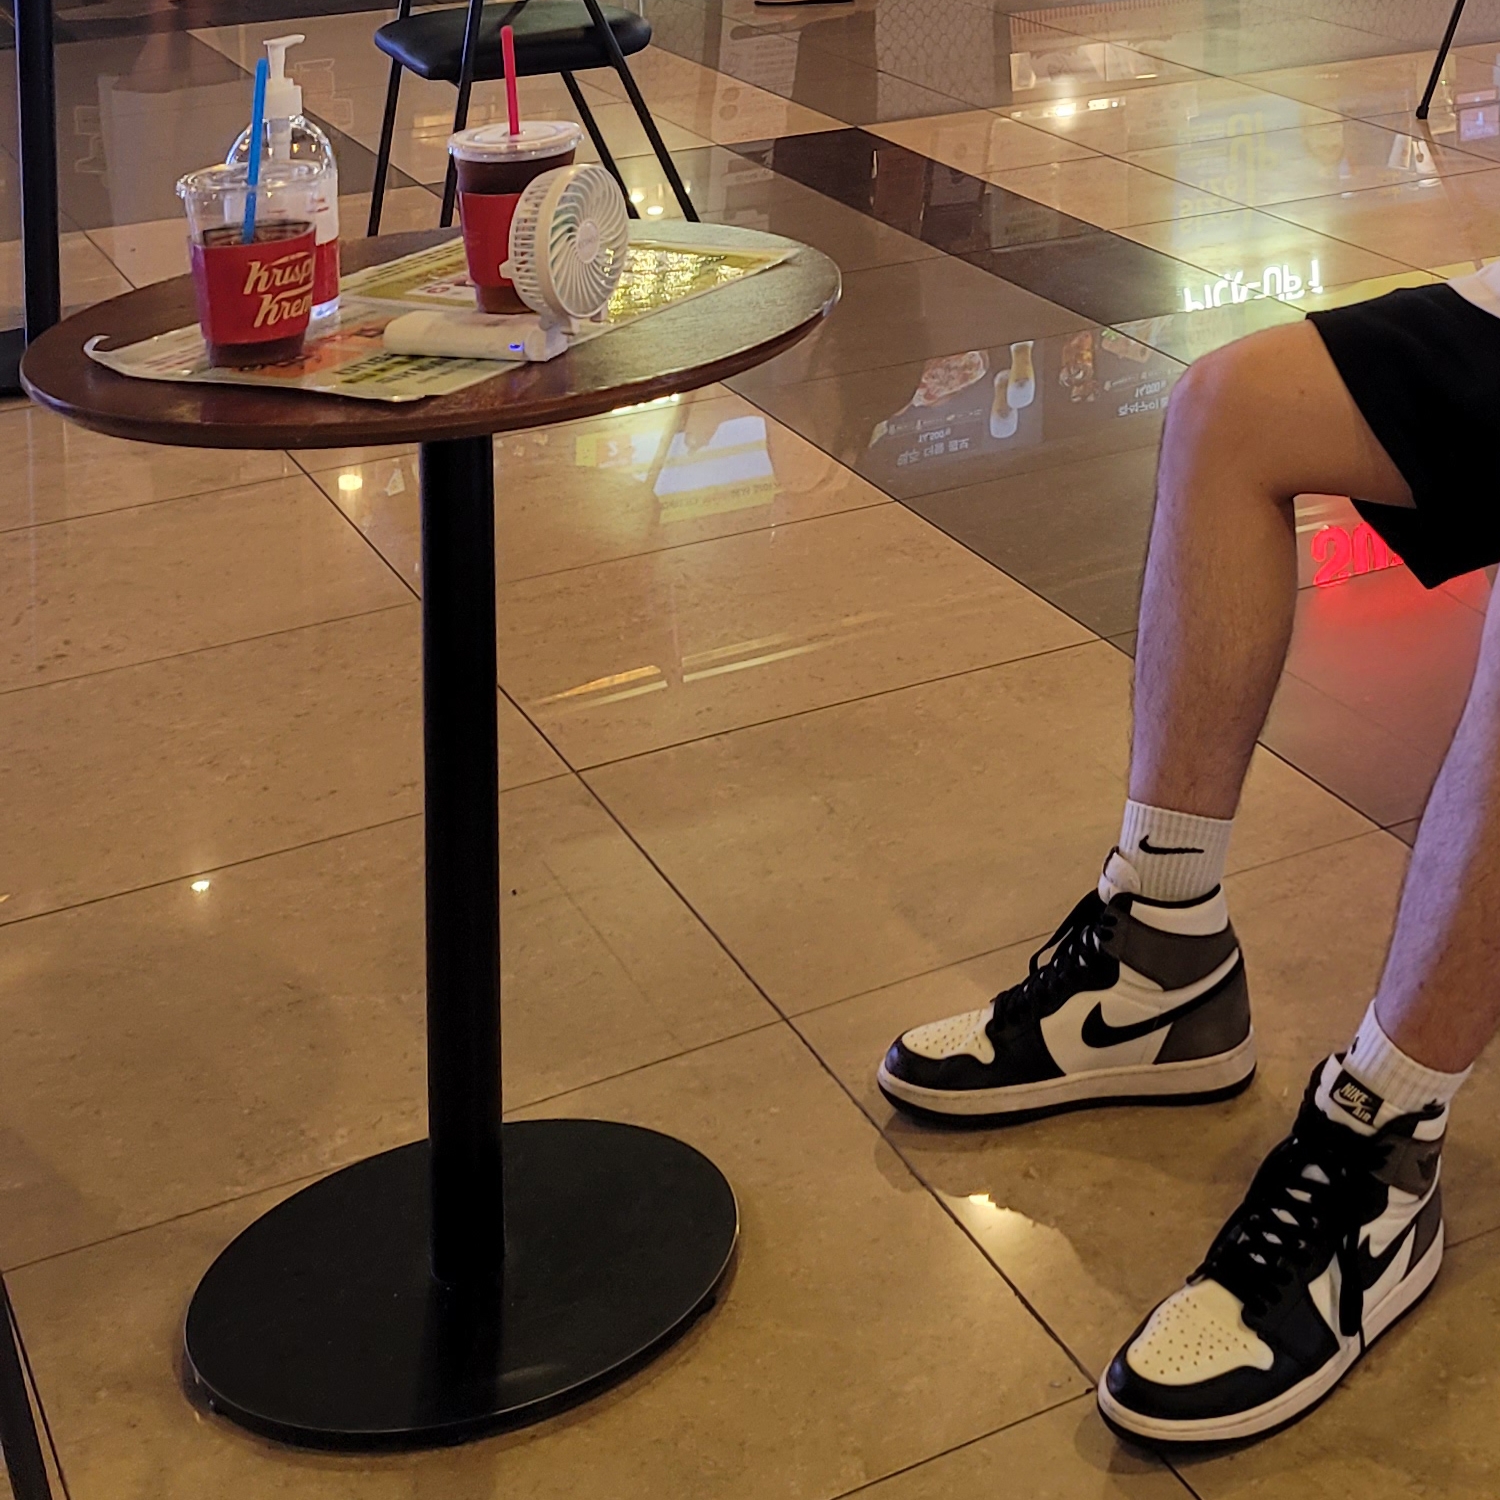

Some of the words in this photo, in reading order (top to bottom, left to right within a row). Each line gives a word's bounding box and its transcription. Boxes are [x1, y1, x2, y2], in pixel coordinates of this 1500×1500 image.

[243, 251, 313, 295] Krisp
[1340, 1082, 1369, 1103] NIKE
[1352, 1106, 1372, 1123] AIR
